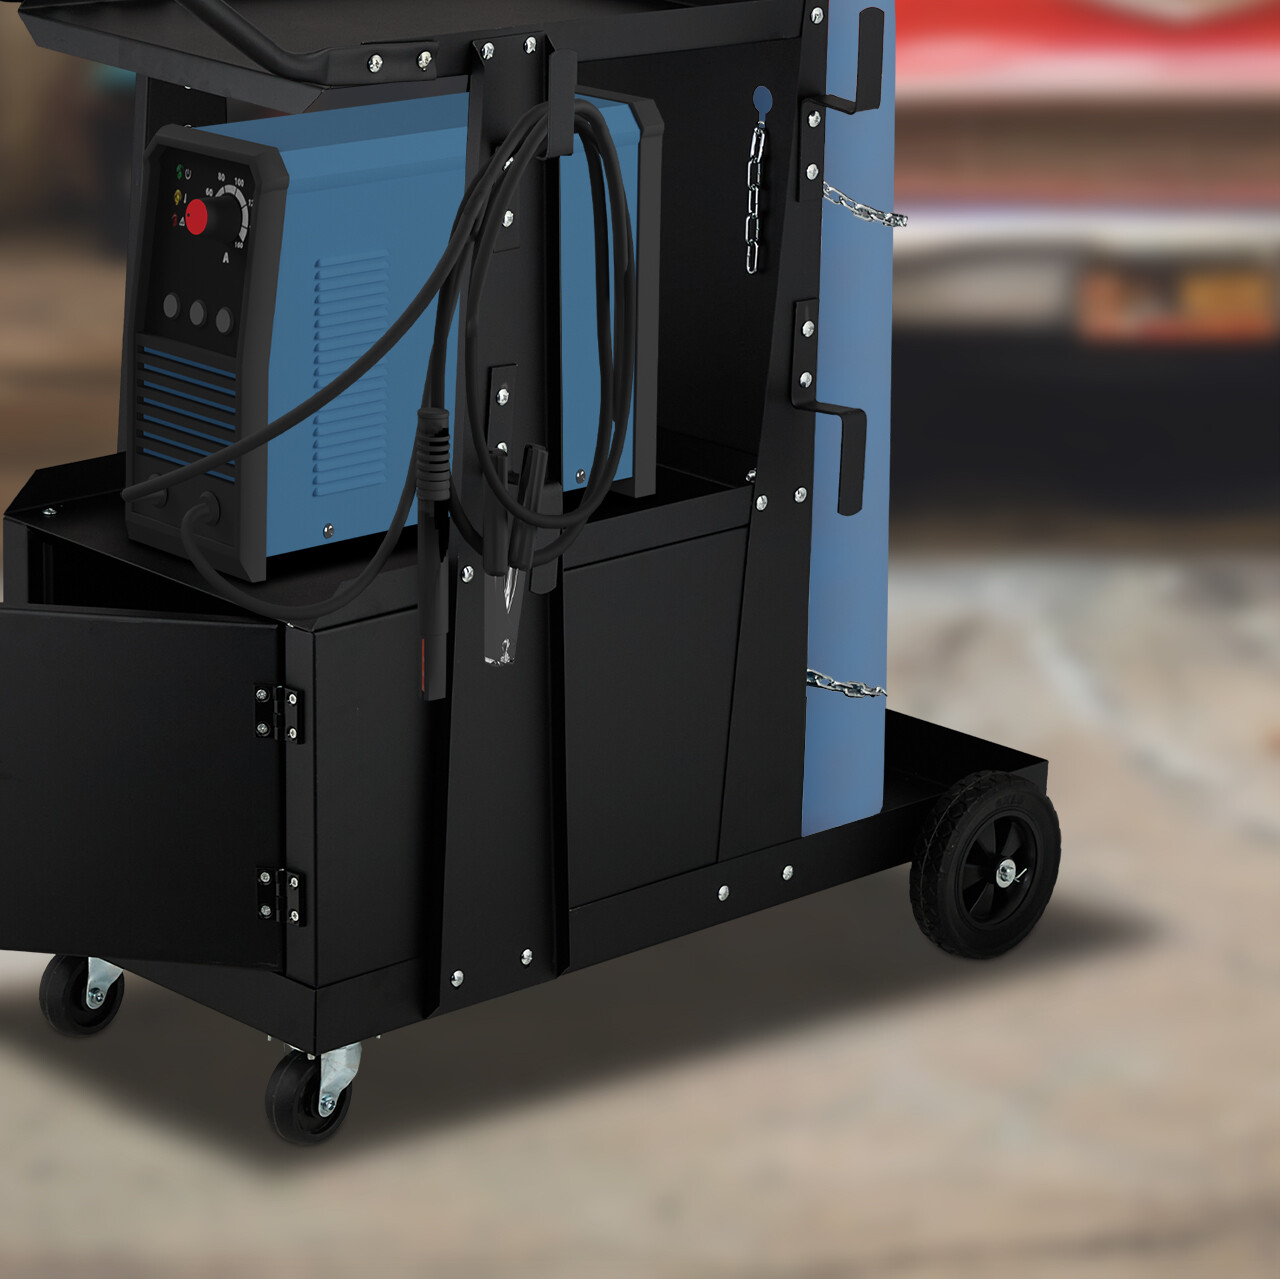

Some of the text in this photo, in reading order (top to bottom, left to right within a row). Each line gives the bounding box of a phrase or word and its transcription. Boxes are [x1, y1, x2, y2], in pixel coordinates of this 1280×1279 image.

[217, 172, 225, 182] 80
[234, 177, 244, 187] 100
[205, 187, 213, 197] 60
[222, 252, 229, 263] A
